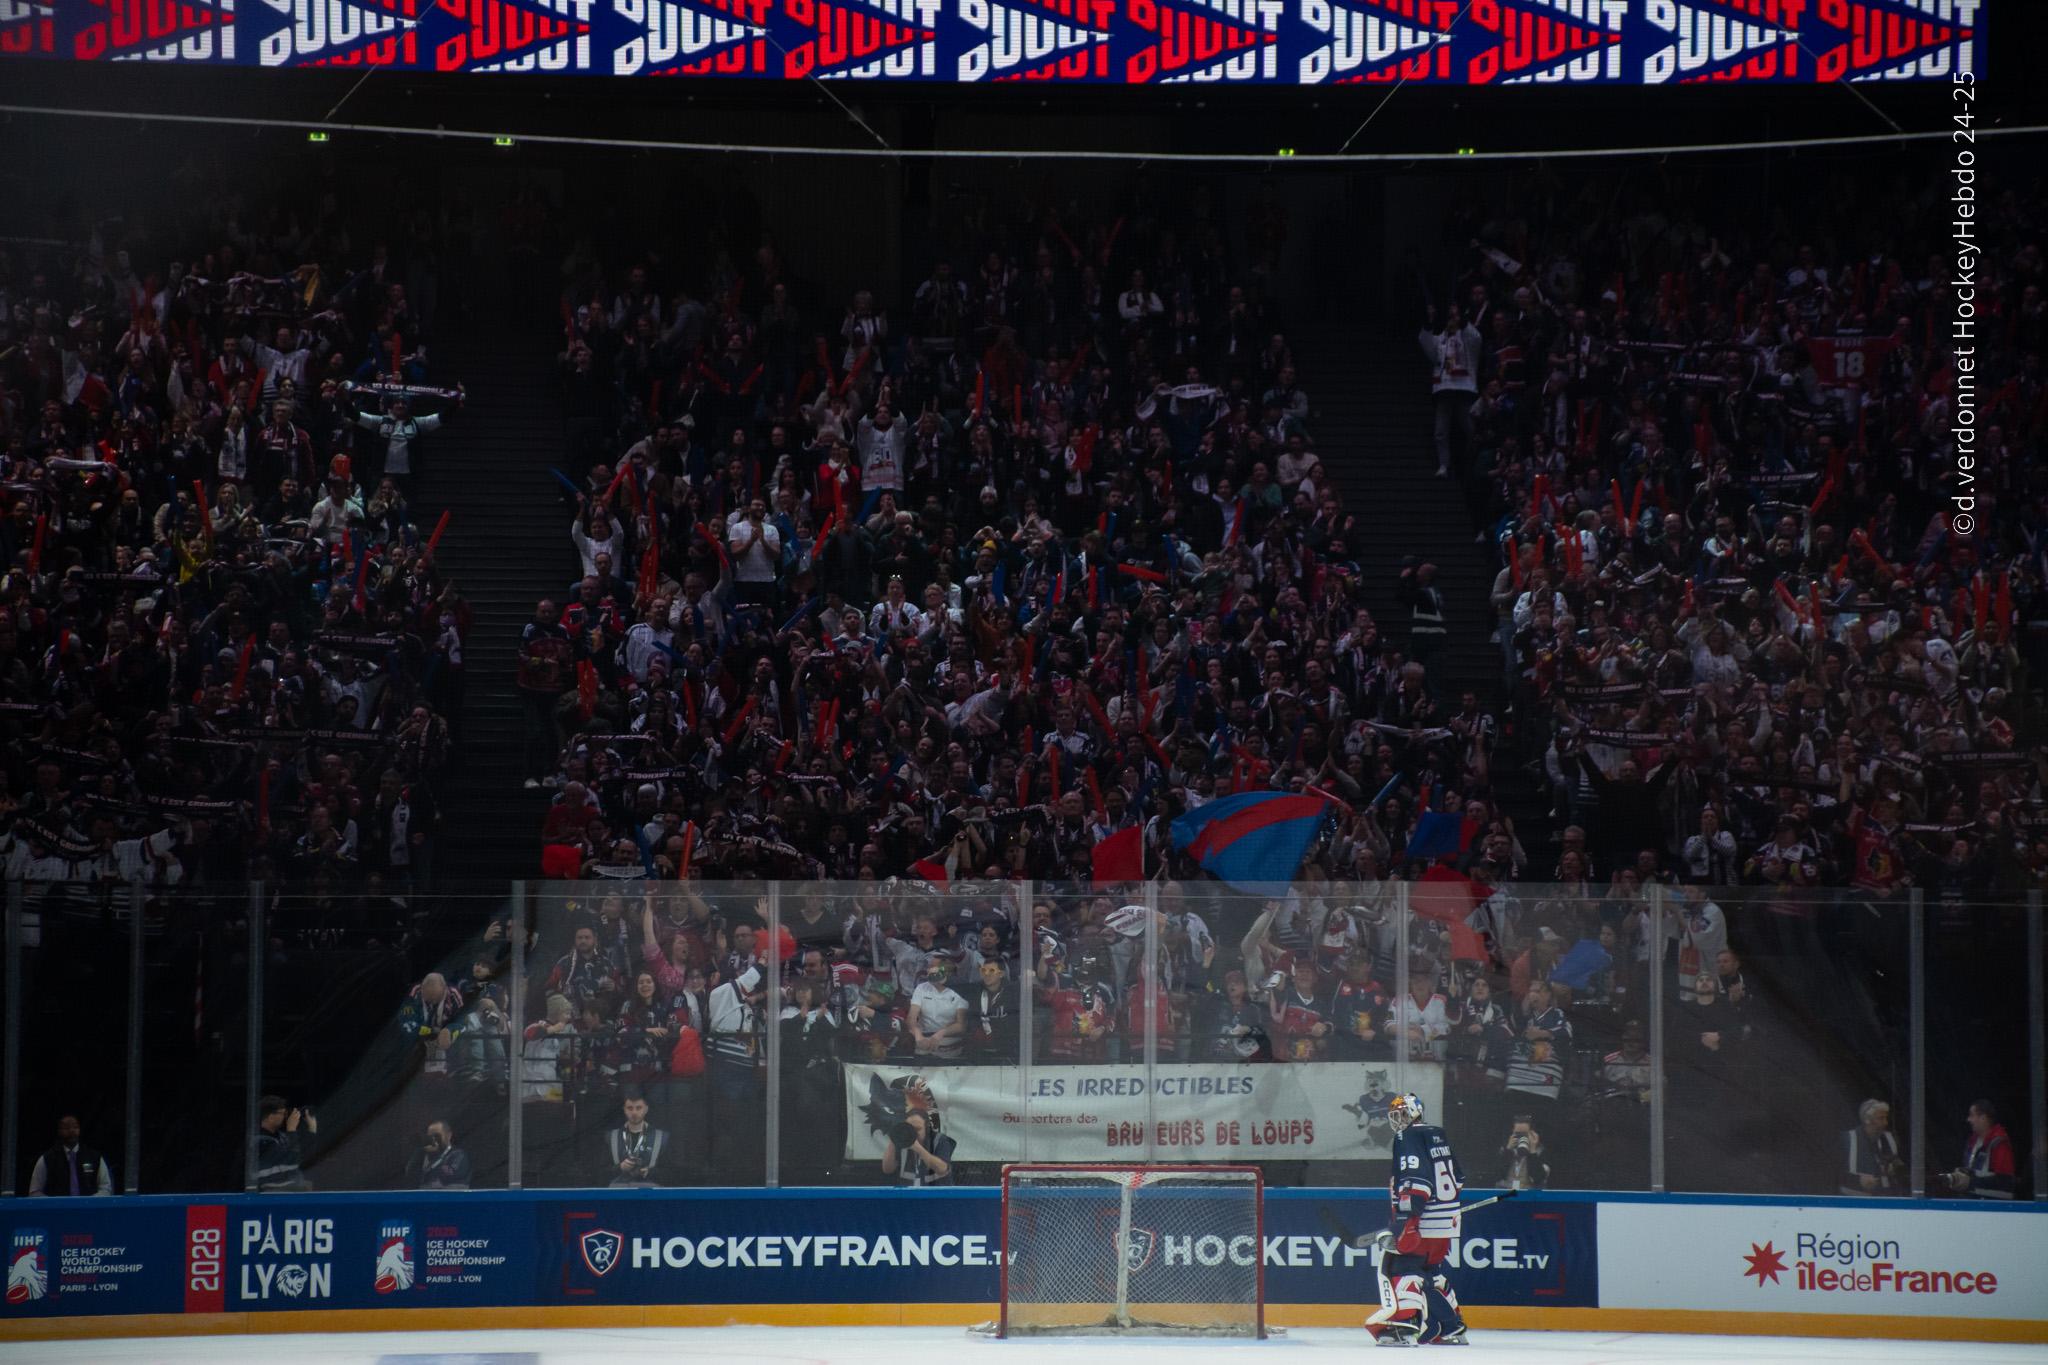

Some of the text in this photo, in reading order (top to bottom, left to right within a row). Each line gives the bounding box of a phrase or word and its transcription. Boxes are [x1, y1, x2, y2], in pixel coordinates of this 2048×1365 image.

[1832, 351, 1865, 378] 18
[1031, 1077, 1253, 1097] ES IRREDCTIBLES
[1107, 1120, 1205, 1147] BRUEURS
[241, 1212, 334, 1255] PARIS
[382, 1227, 411, 1238] IIHF
[14, 1234, 45, 1247] IIHF
[426, 1239, 489, 1249] ICE HOCKEY
[60, 1247, 126, 1258] ICE HOCKEY
[426, 1248, 465, 1257] WORLD
[1796, 1232, 1900, 1265] Région
[60, 1257, 101, 1266] WORLD
[190, 1228, 221, 1292] 2028
[426, 1256, 507, 1266] CHAMPIONSHIP
[60, 1264, 144, 1275] CHAMPIONSHIP
[425, 1275, 451, 1284] PARIS
[458, 1275, 482, 1283] LYON
[60, 1284, 87, 1293] PARIS
[93, 1283, 119, 1292] LYON
[1382, 1280, 1392, 1308] CCM
